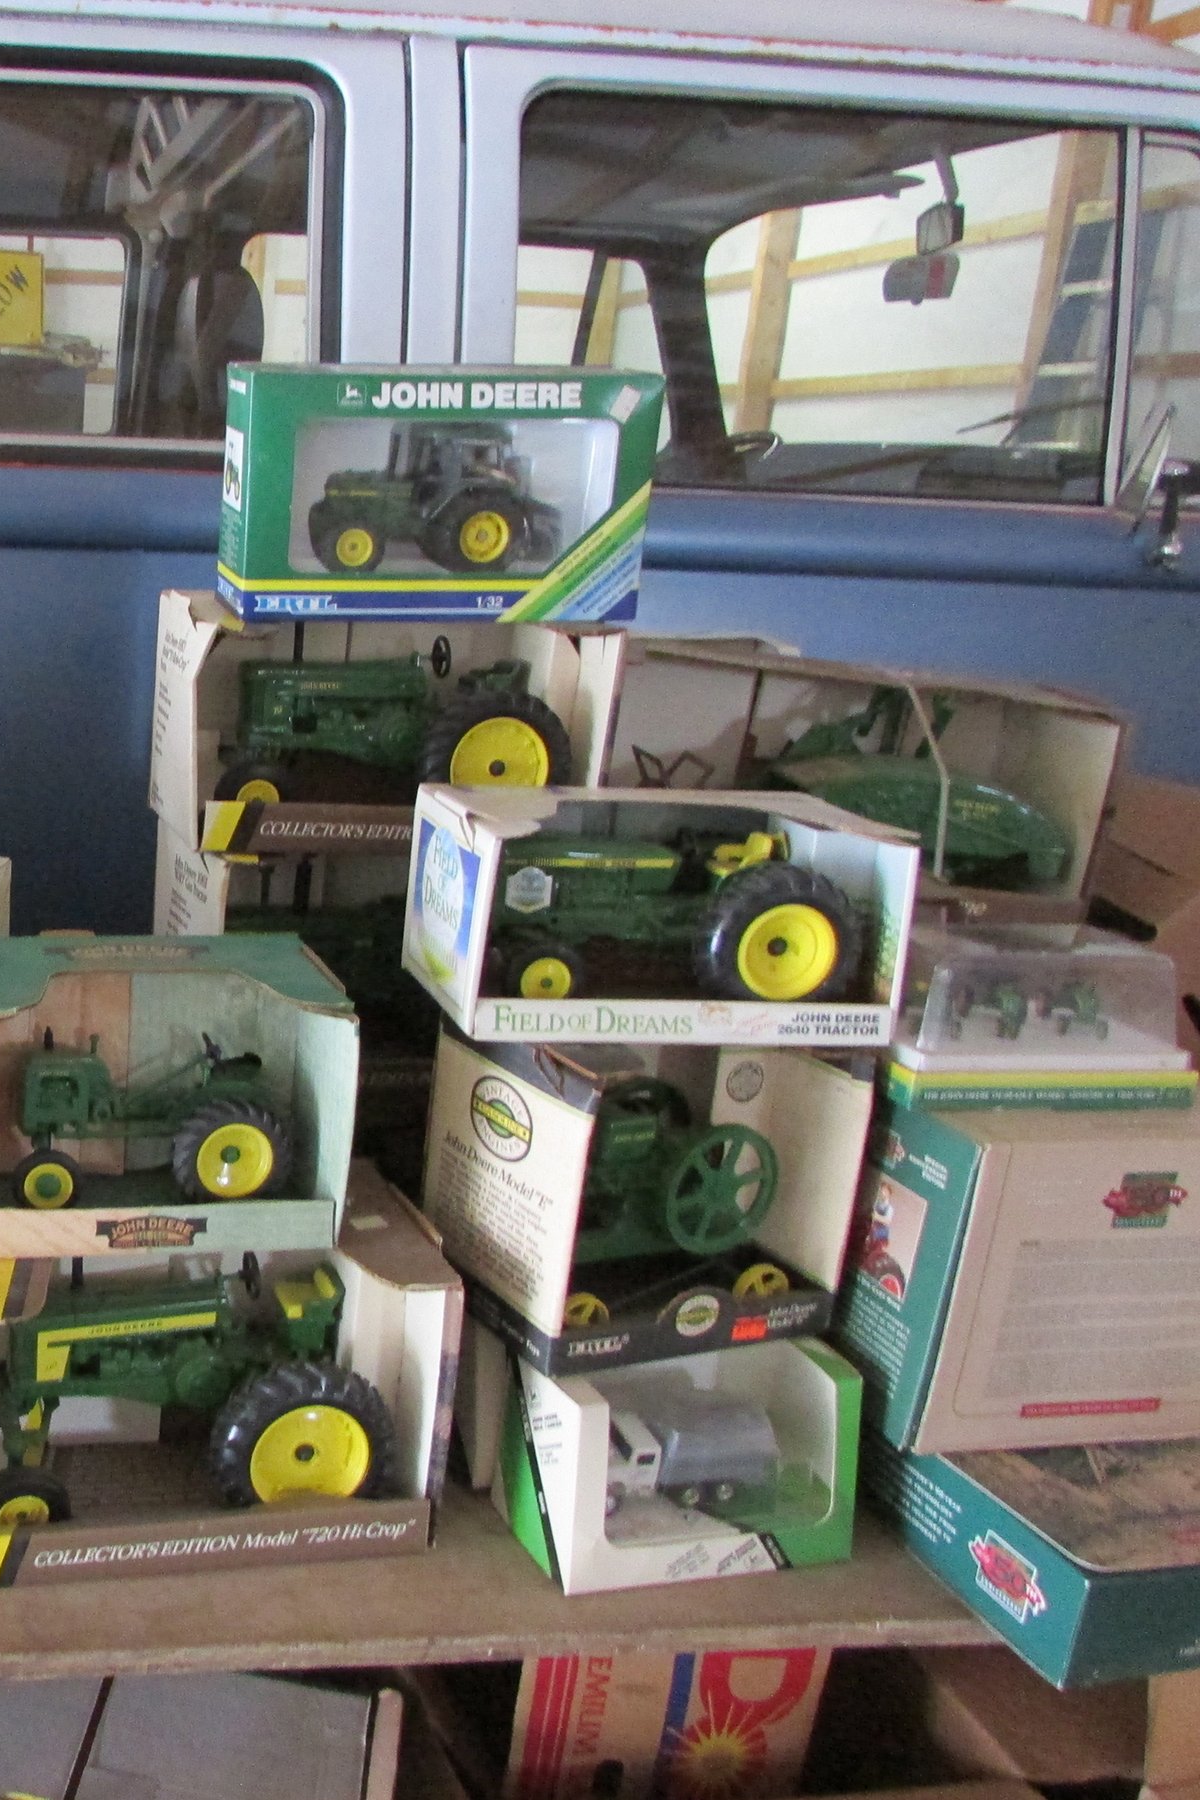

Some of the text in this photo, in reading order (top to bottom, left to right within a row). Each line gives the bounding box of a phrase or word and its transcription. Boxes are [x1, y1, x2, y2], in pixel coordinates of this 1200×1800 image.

[371, 381, 582, 410] JOHN DEERE
[254, 594, 338, 616] ERTL
[475, 594, 504, 609] 1/32
[259, 820, 364, 839] COLLECTOR'S
[433, 835, 458, 881] FIELD
[424, 875, 458, 930] DREAMS
[492, 1003, 693, 1036] FIELD OF DREAMS
[791, 1013, 831, 1024] JOHN
[835, 1013, 881, 1024] DEERE
[813, 1024, 880, 1036] TRACTOR
[499, 1168, 535, 1201] Model
[111, 1219, 146, 1240] JOHN
[148, 1218, 195, 1236] DEERE
[33, 1543, 160, 1568] COLLECTOR'S
[160, 1534, 240, 1557] EDITION
[242, 1529, 299, 1550] Model
